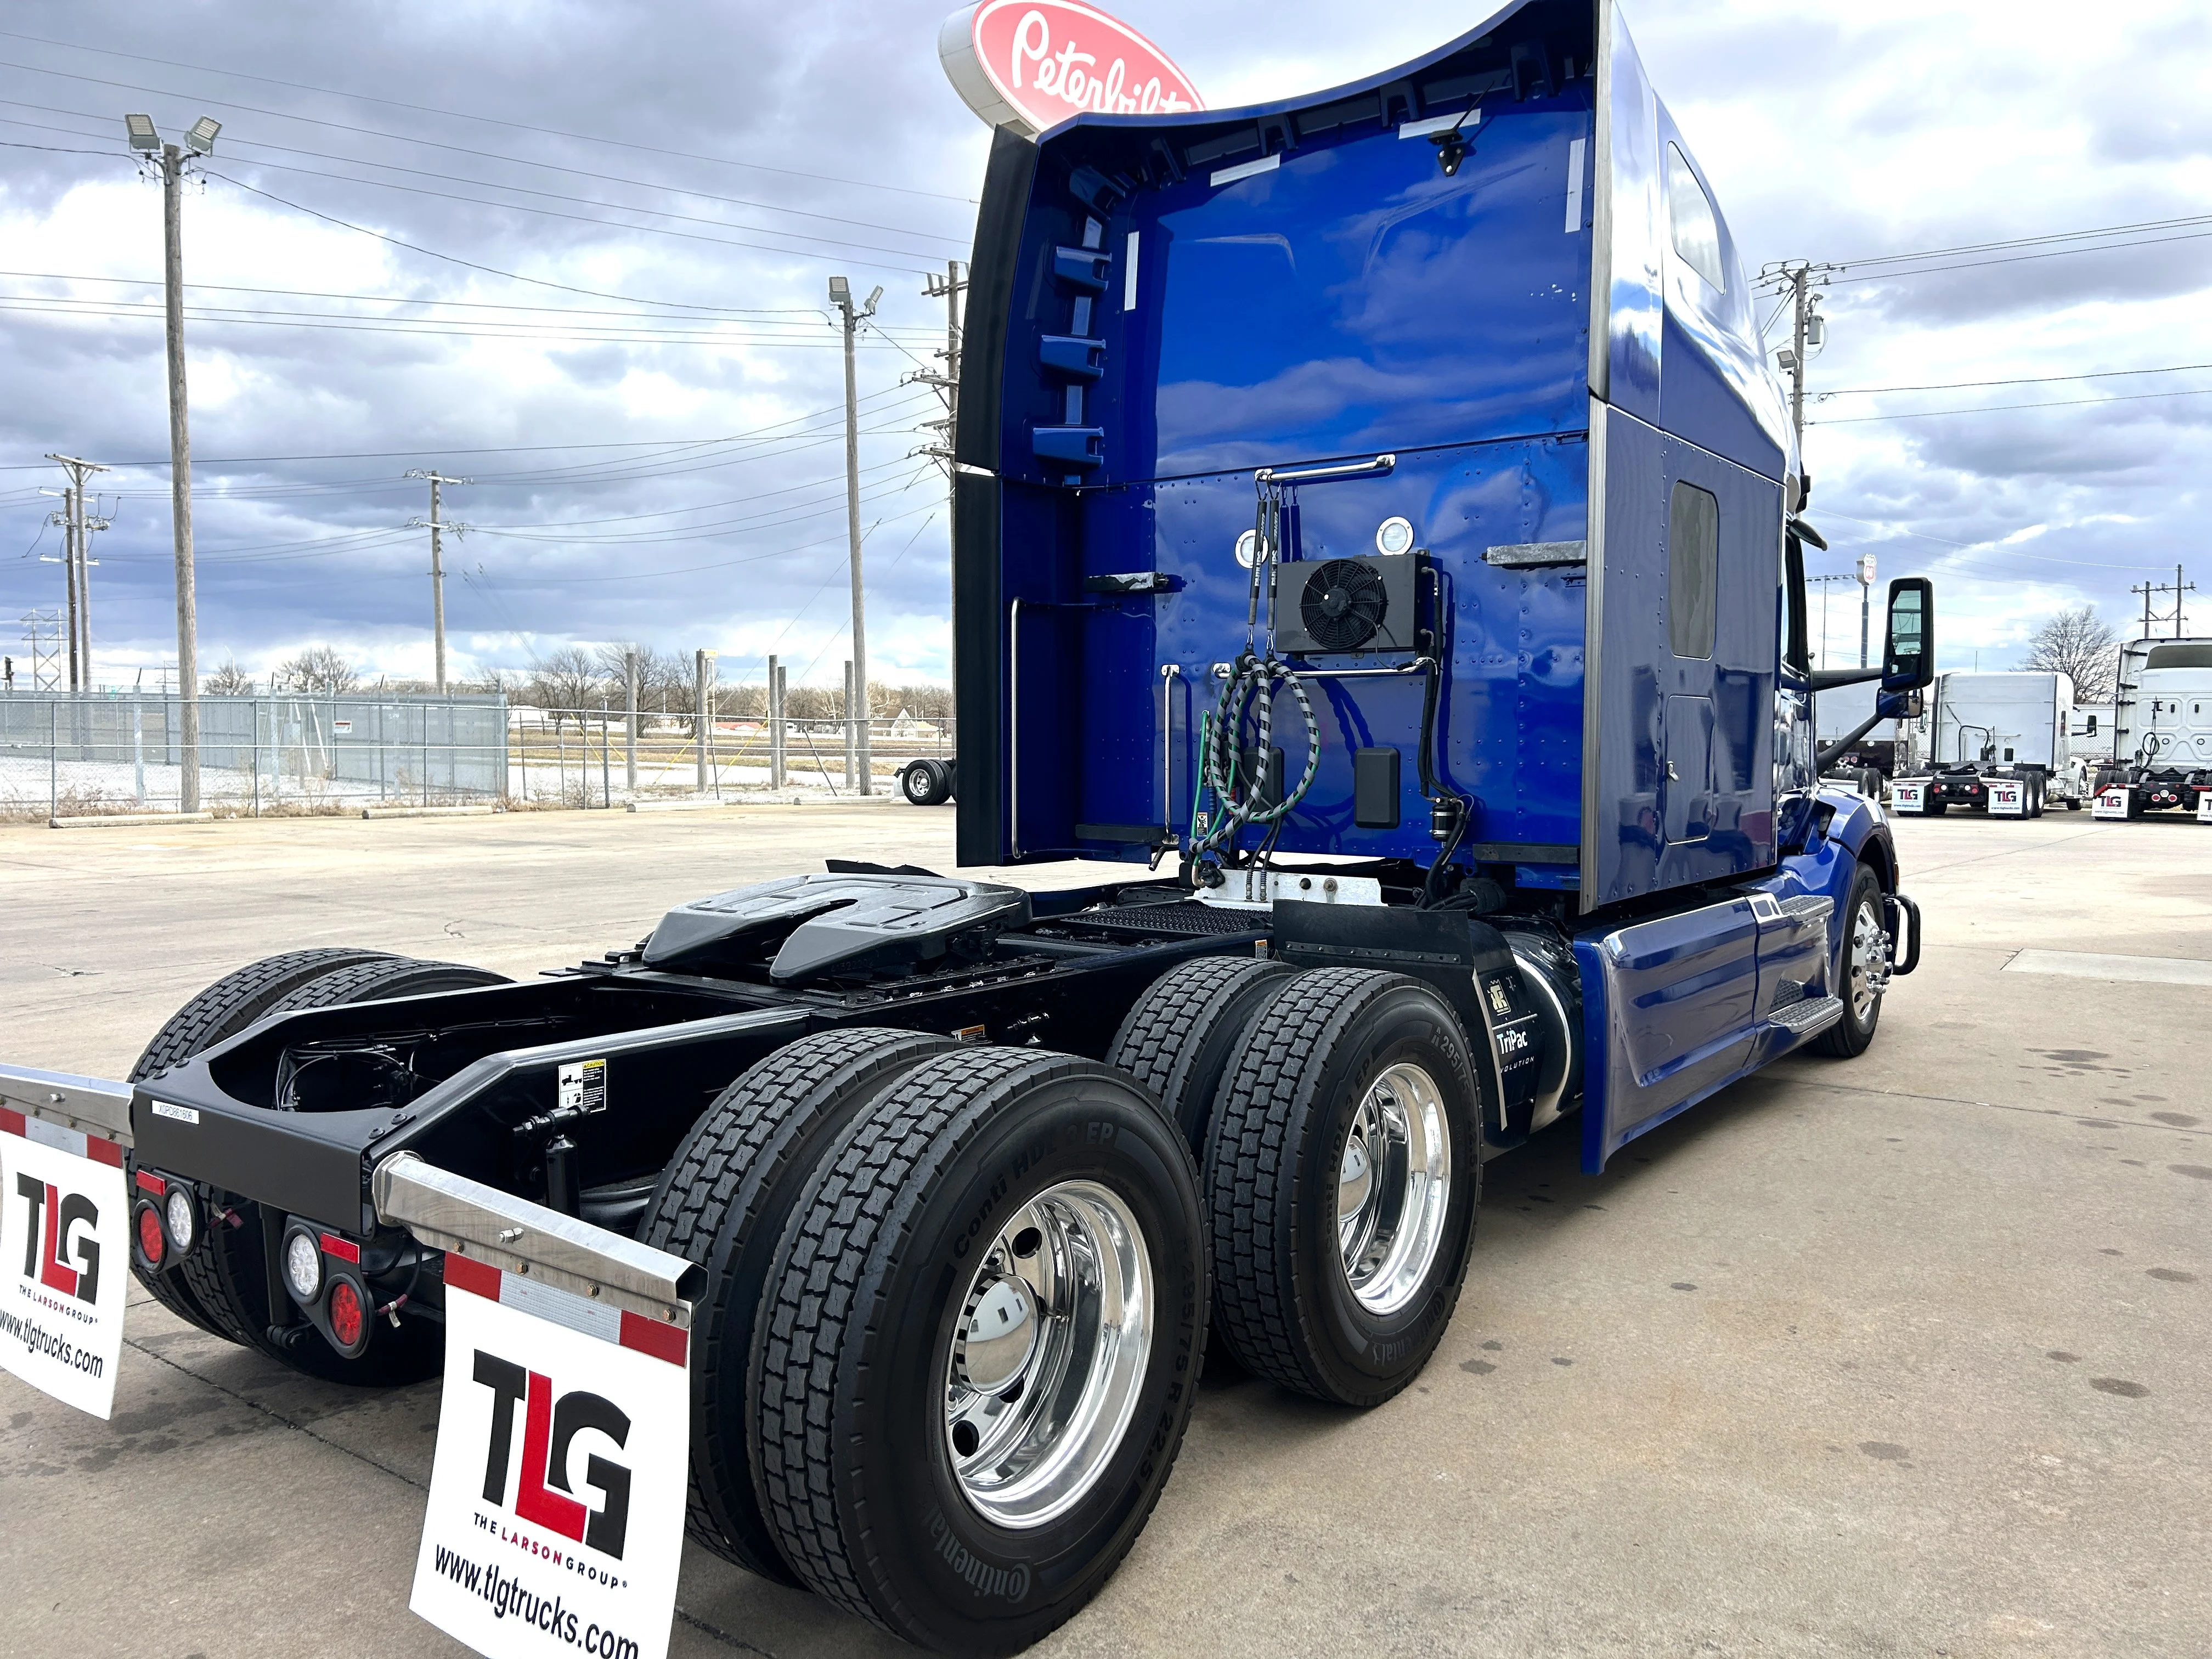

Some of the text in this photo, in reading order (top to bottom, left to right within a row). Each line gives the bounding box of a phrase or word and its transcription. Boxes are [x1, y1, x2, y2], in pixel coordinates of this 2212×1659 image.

[1897, 789, 1918, 800] TLG
[1994, 791, 2017, 802] TLG
[2098, 795, 2121, 807] TLG
[1497, 1029, 1528, 1054] TriPac
[1500, 1056, 1534, 1074] VOLUTION
[953, 1175, 1009, 1260] Conti
[1085, 1121, 1115, 1146] EP
[16, 1171, 100, 1306] TLG
[19, 1284, 31, 1298] THE
[33, 1291, 65, 1313] LARSON
[473, 1348, 631, 1561] TLG
[474, 1511, 498, 1534] THE
[501, 1526, 562, 1566] LARSON
[436, 1543, 639, 1659] www.tlgtrucks.com
